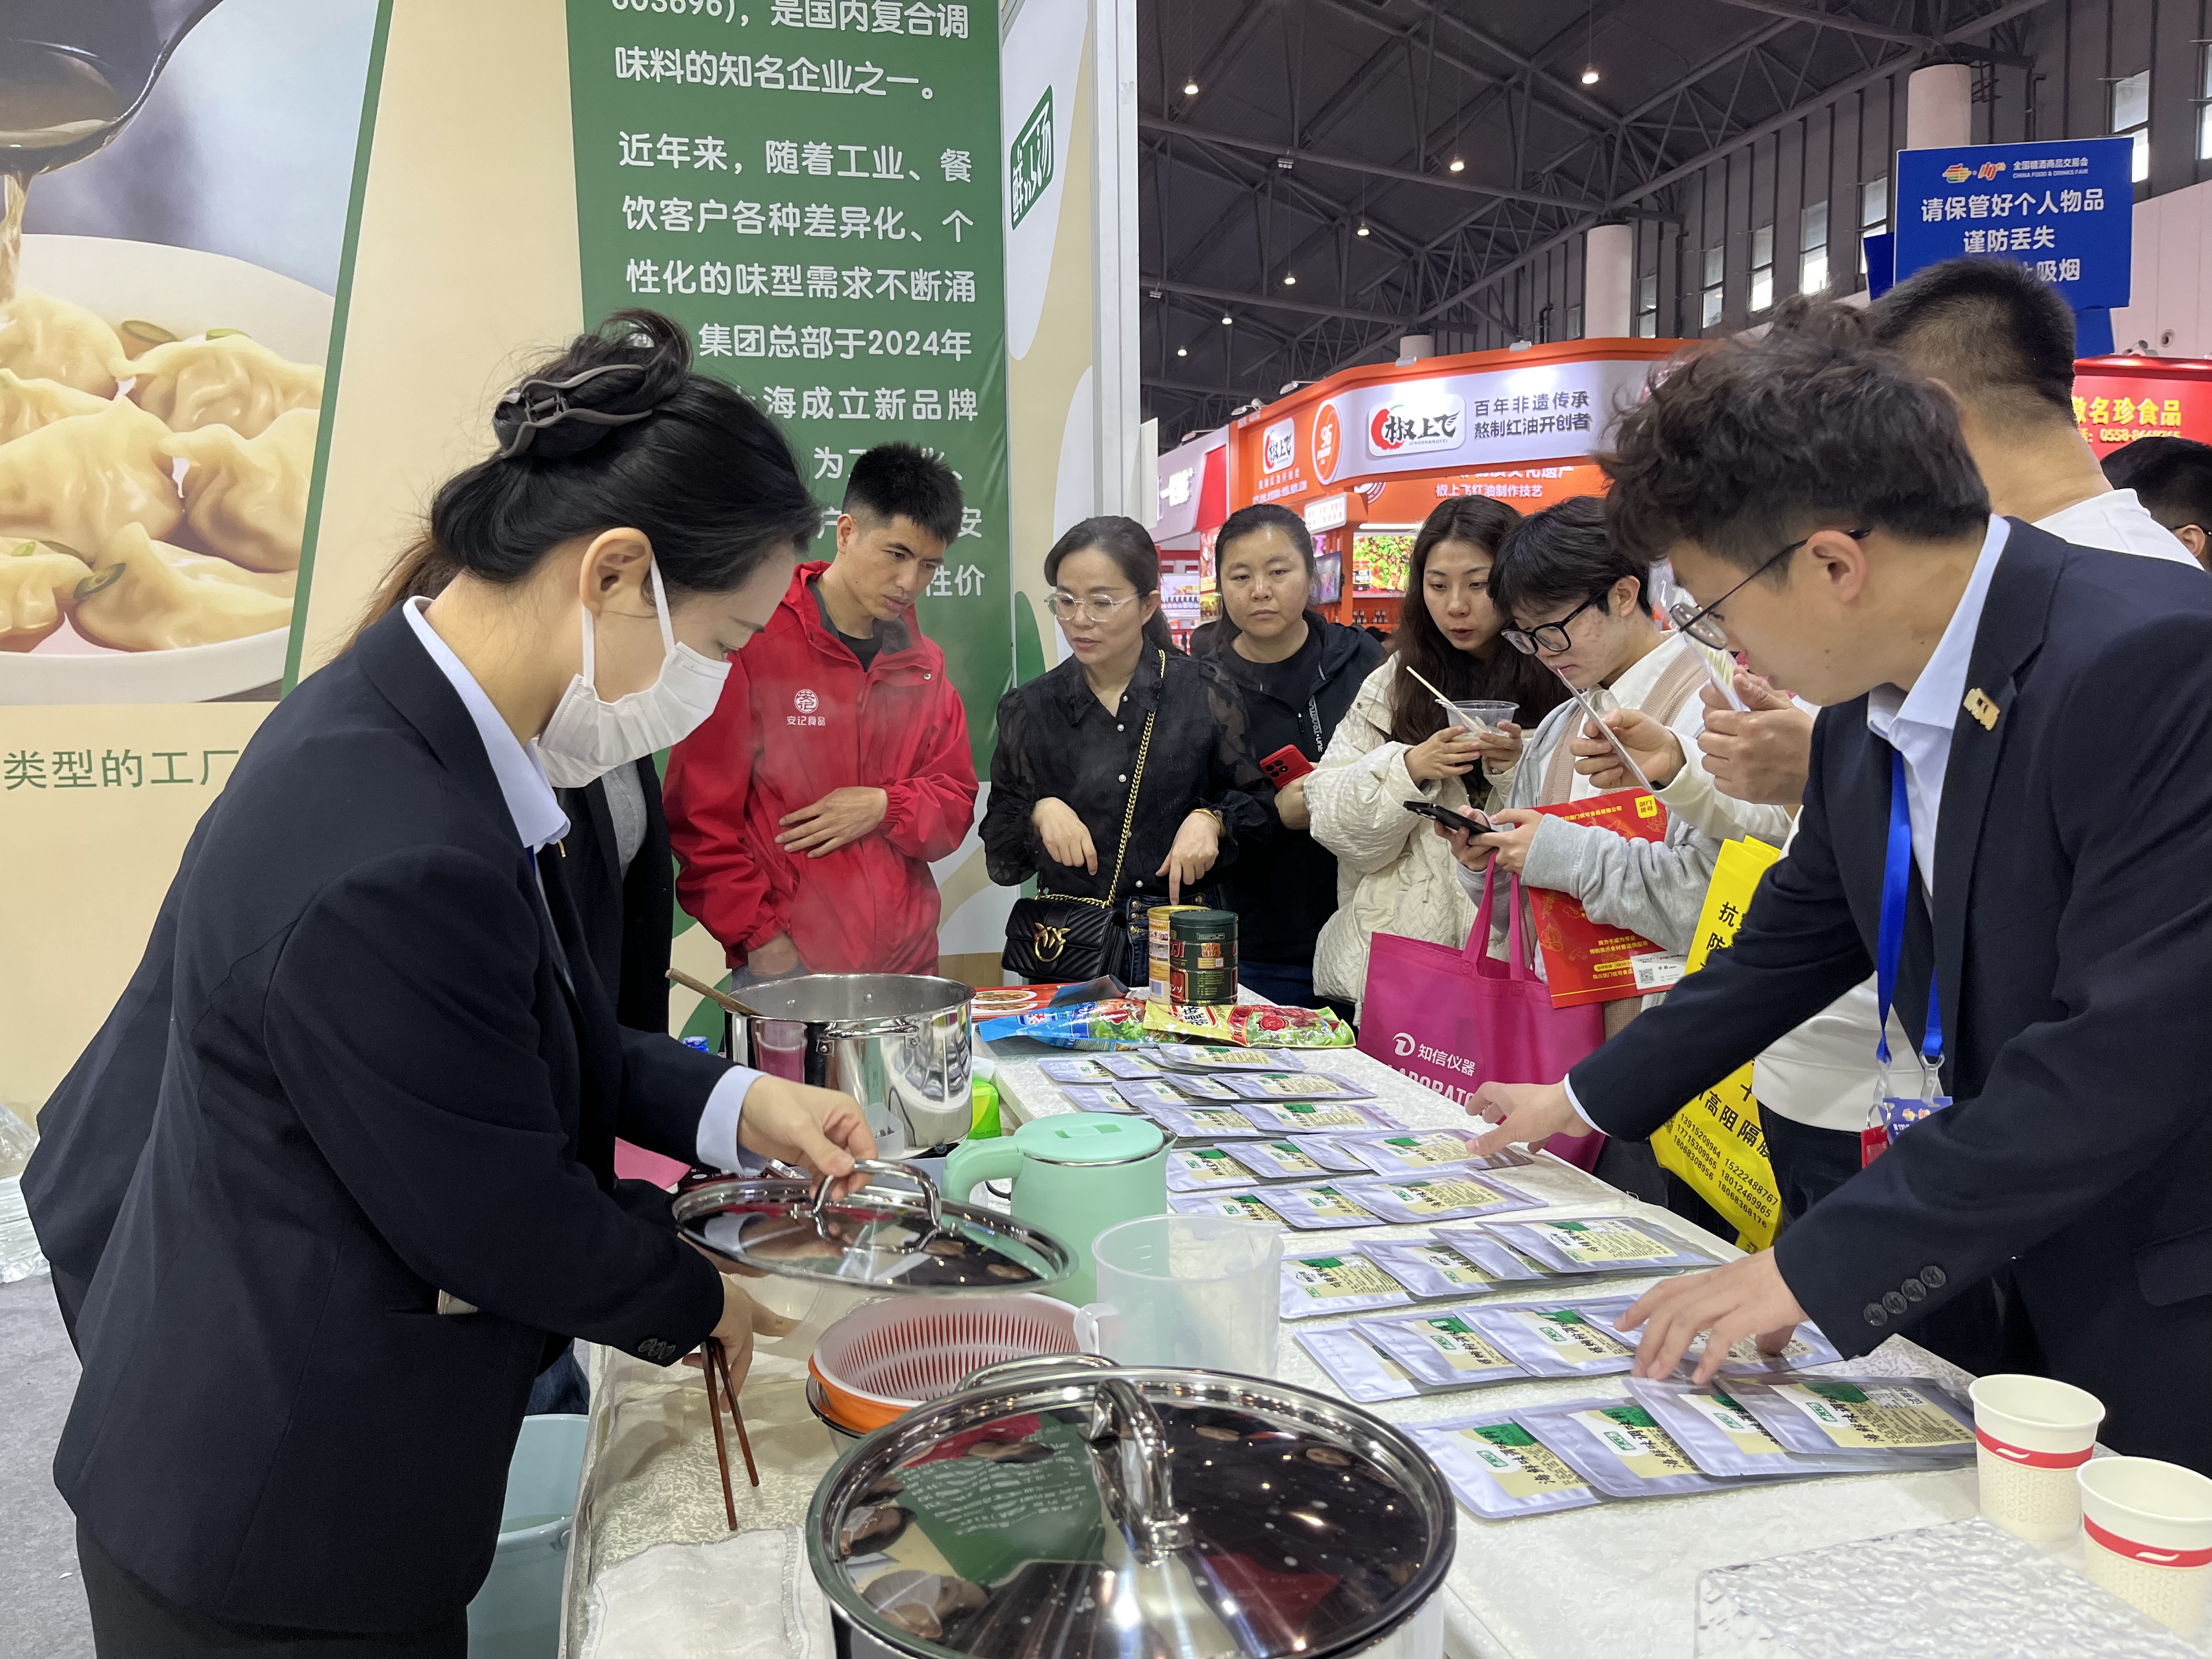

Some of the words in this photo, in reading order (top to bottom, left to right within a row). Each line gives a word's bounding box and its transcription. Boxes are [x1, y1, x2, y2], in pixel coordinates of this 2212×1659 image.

[614, 46, 934, 100] 味料的知名企业之一。
[618, 131, 973, 184] 近年来，随着工业、餐
[622, 195, 974, 245] 饮客户各种差异化、个
[1921, 188, 2105, 222] 请保管好个人物品
[1963, 225, 2055, 253] 谨防丢失
[625, 258, 976, 304] 性化的味型需求不断涌
[698, 322, 972, 363] 集团总部于2024年
[1474, 391, 1590, 417] 百年非遗传承
[1474, 413, 1591, 439] 熬制红油开创者
[787, 715, 826, 726] 安记食品
[4, 749, 239, 791] 类型的工厂
[1417, 1043, 1476, 1076] 知信仪器
[1699, 1090, 1770, 1158] 高阻隔
[1674, 1135, 1713, 1181] 18068308956
[1718, 1180, 1767, 1228] 18068368176
[1677, 1124, 1717, 1169] 17715309965
[1721, 1170, 1773, 1217] 18012469965
[1680, 1113, 1722, 1158] 13915209964
[1725, 1158, 1779, 1206] 15222488767
